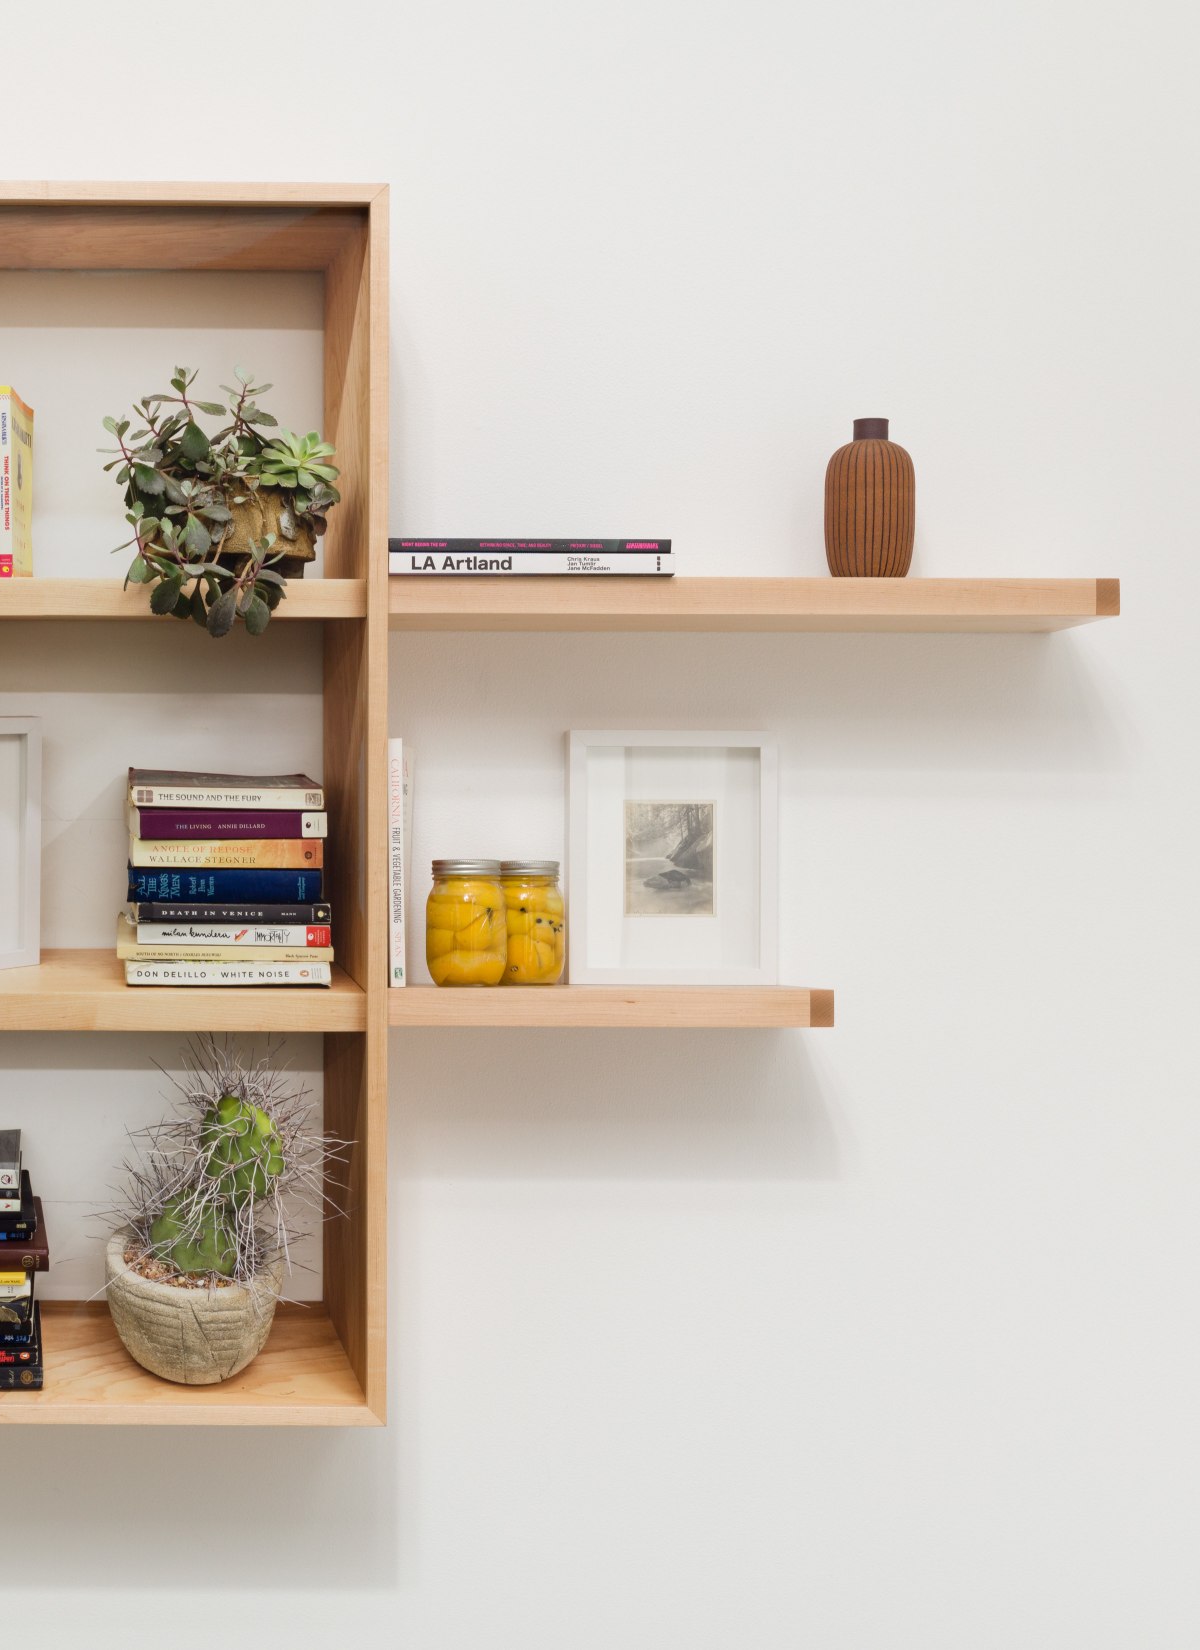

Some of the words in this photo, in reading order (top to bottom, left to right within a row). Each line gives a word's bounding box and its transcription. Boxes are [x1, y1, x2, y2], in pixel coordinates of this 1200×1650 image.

[4, 476, 9, 486] ON
[412, 556, 436, 570] LA
[442, 556, 512, 570] Artland
[391, 758, 400, 825] CALIFORNIA
[392, 827, 400, 844] FRUIT
[393, 853, 401, 887] VEGETABLE
[148, 878, 156, 894] THE
[170, 874, 180, 898] MEN
[393, 888, 402, 924] GARDENING
[161, 928, 187, 936] milan
[189, 927, 230, 938] kundera
